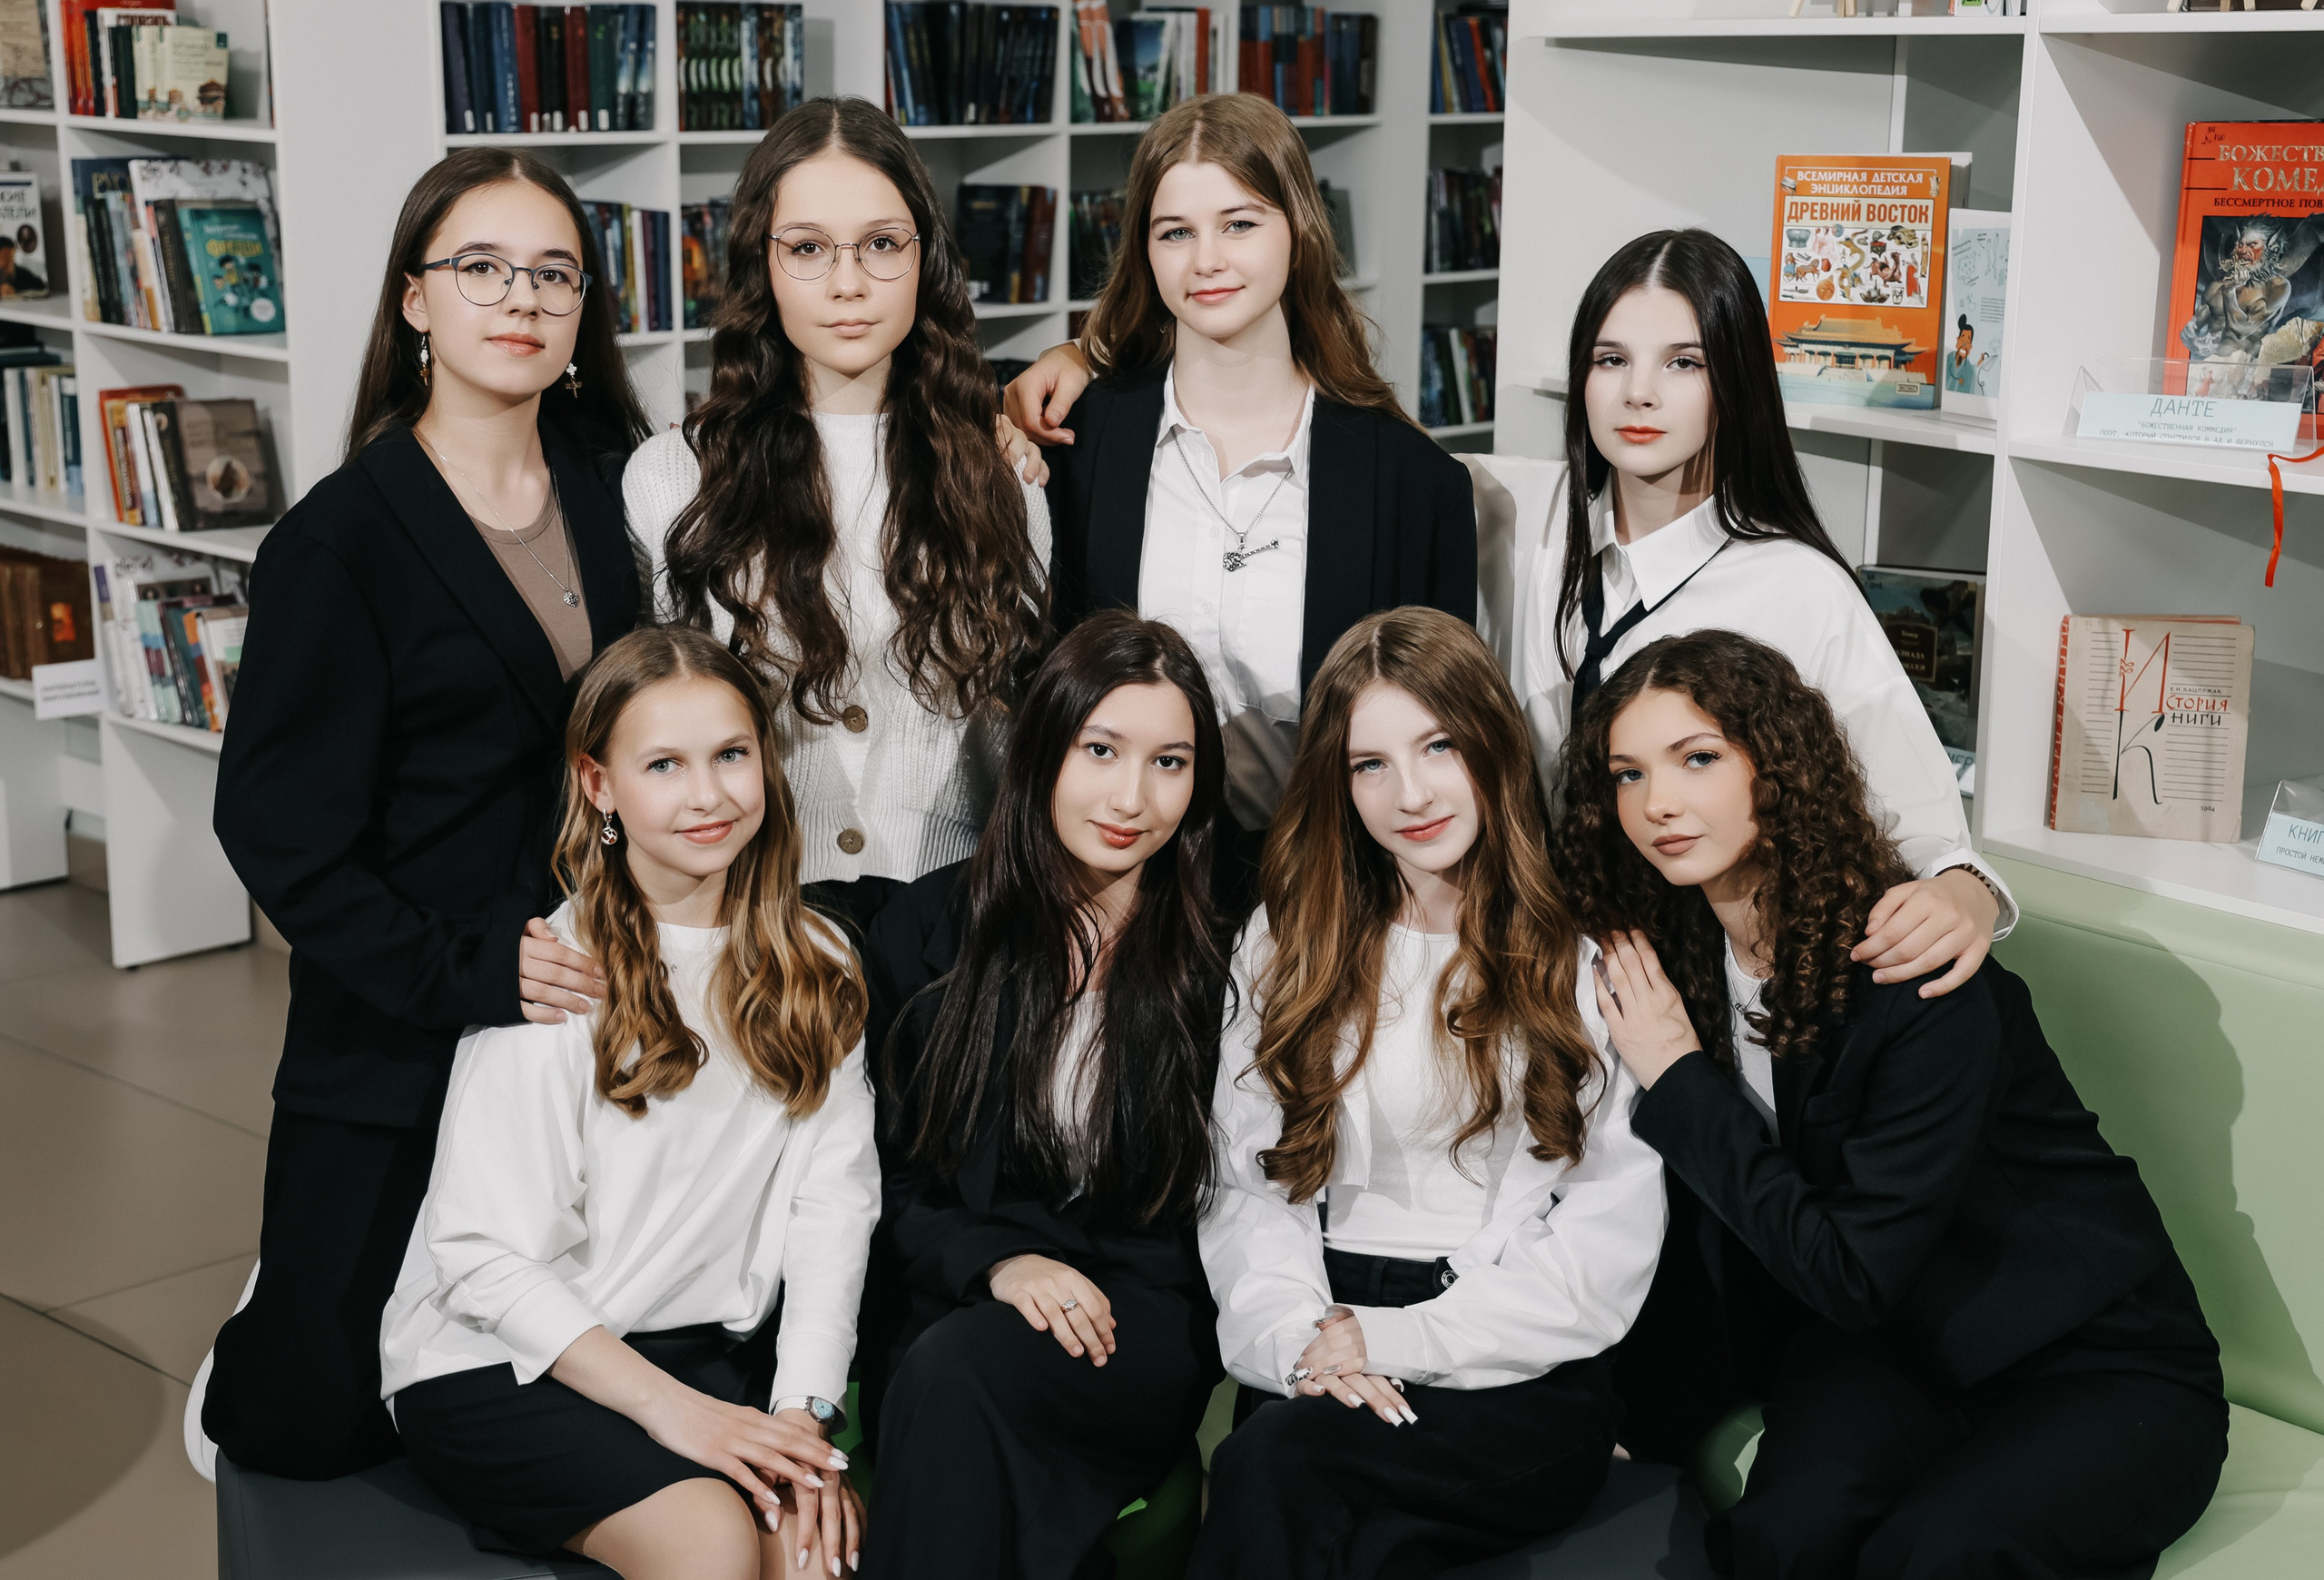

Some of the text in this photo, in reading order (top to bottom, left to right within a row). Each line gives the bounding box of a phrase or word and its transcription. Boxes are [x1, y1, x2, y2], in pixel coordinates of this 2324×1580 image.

[2218, 144, 2324, 162] БОЖЕСТВ
[1797, 170, 1924, 183] ВСЕМИРНАЯ ДЕТСКАЯ
[2231, 167, 2324, 196] КОМЕ
[1810, 183, 1907, 196] ЭНЦИКЛОПЕДИЯ
[1787, 199, 1930, 224] ДРЕВНИЙ ВОСТОК
[2213, 197, 2324, 209] БЕССМЕРТНОЕ ПОВ
[2150, 398, 2218, 419] ДАНТЕ
[2138, 421, 2193, 431] "БОЖЕСТВЕННАЯ
[2276, 845, 2324, 865] ПРОСТОЙ НЕМ
